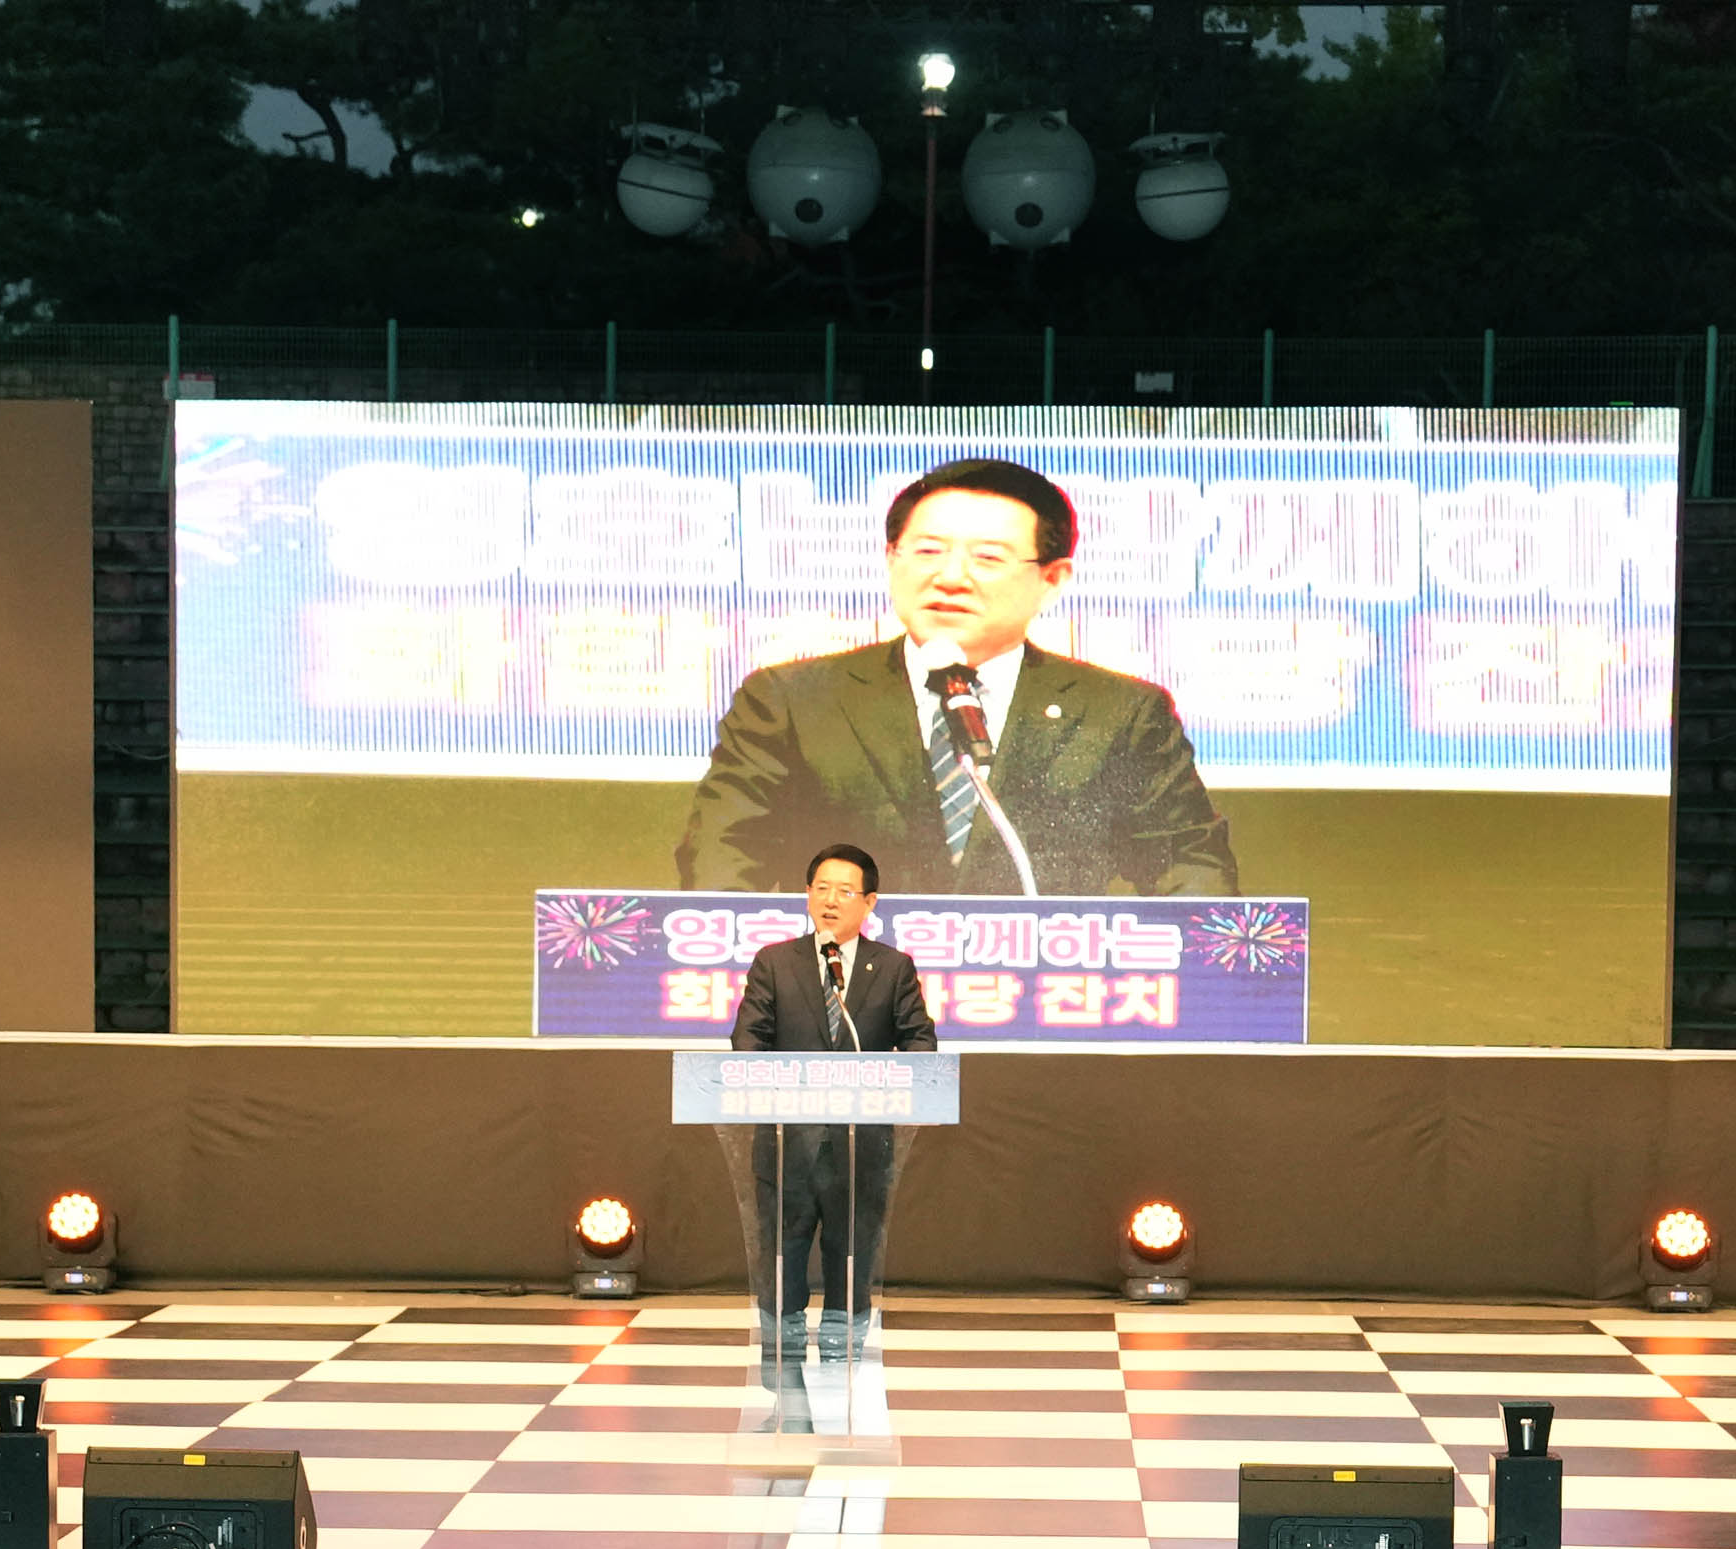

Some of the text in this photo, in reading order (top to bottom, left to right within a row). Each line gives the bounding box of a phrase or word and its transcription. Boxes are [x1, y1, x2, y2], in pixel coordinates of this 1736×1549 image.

[893, 911, 1185, 969] 함께하는
[1041, 976, 1178, 1025] 잔치
[720, 1059, 913, 1088] 영호남 함께하는
